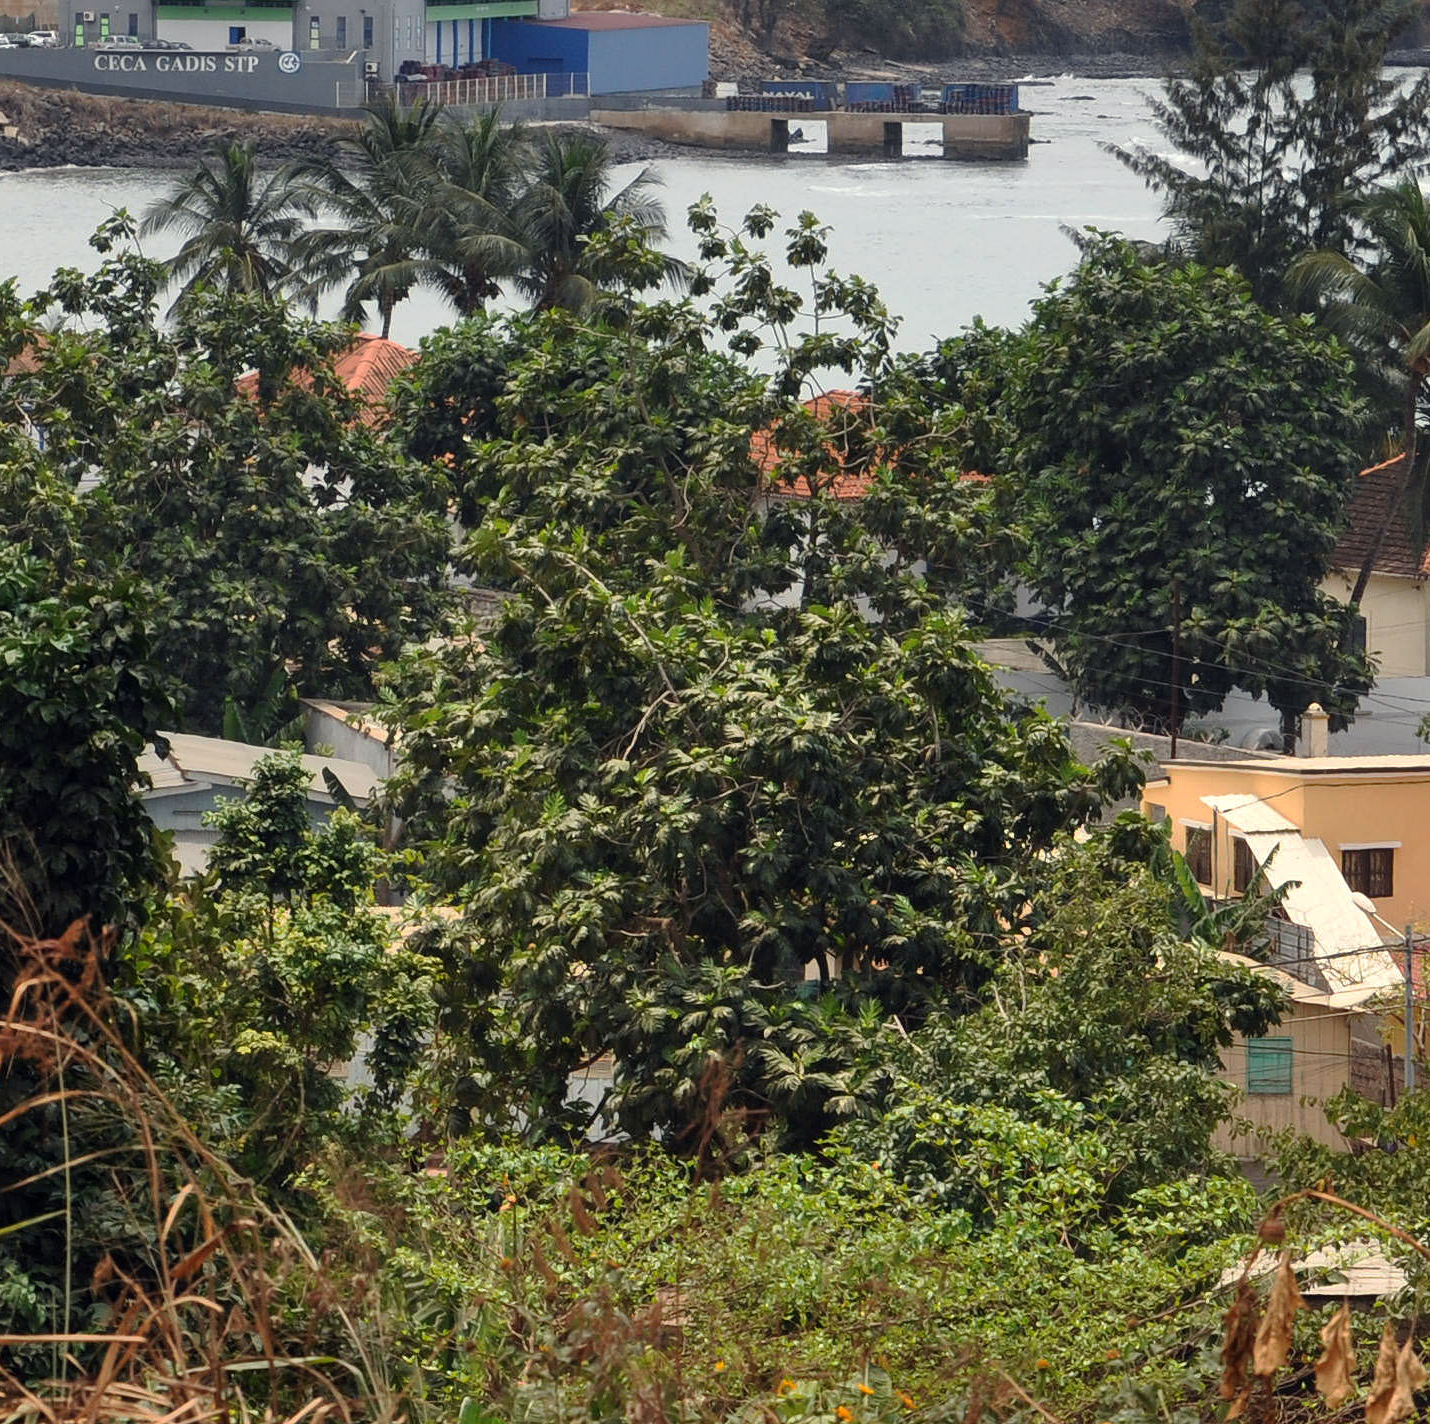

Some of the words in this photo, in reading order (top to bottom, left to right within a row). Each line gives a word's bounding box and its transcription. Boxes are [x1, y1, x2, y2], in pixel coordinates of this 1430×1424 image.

[94, 54, 147, 71] CECA
[155, 55, 217, 72] GADIS
[224, 56, 259, 73] STP
